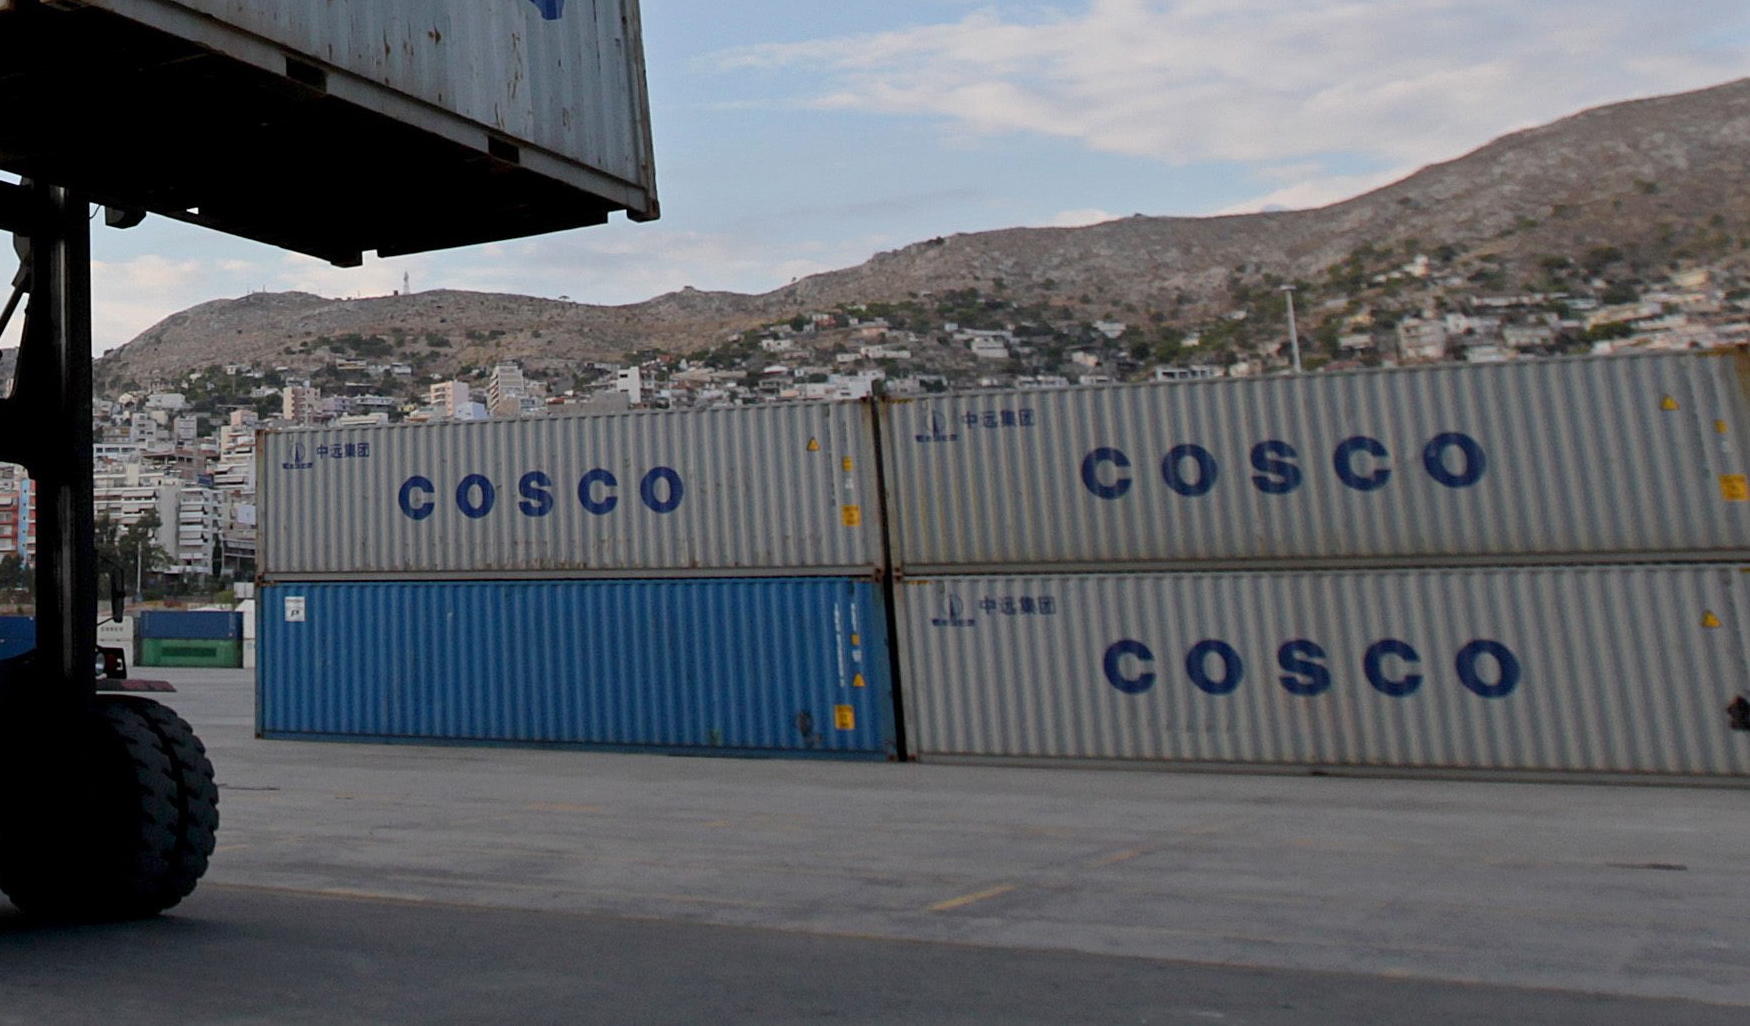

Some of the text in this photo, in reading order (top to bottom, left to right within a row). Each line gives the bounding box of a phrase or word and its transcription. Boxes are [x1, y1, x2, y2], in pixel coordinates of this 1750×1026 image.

[398, 466, 684, 521] COSCO
[1082, 432, 1486, 500] COSCO
[1103, 638, 1522, 699] COSCO
